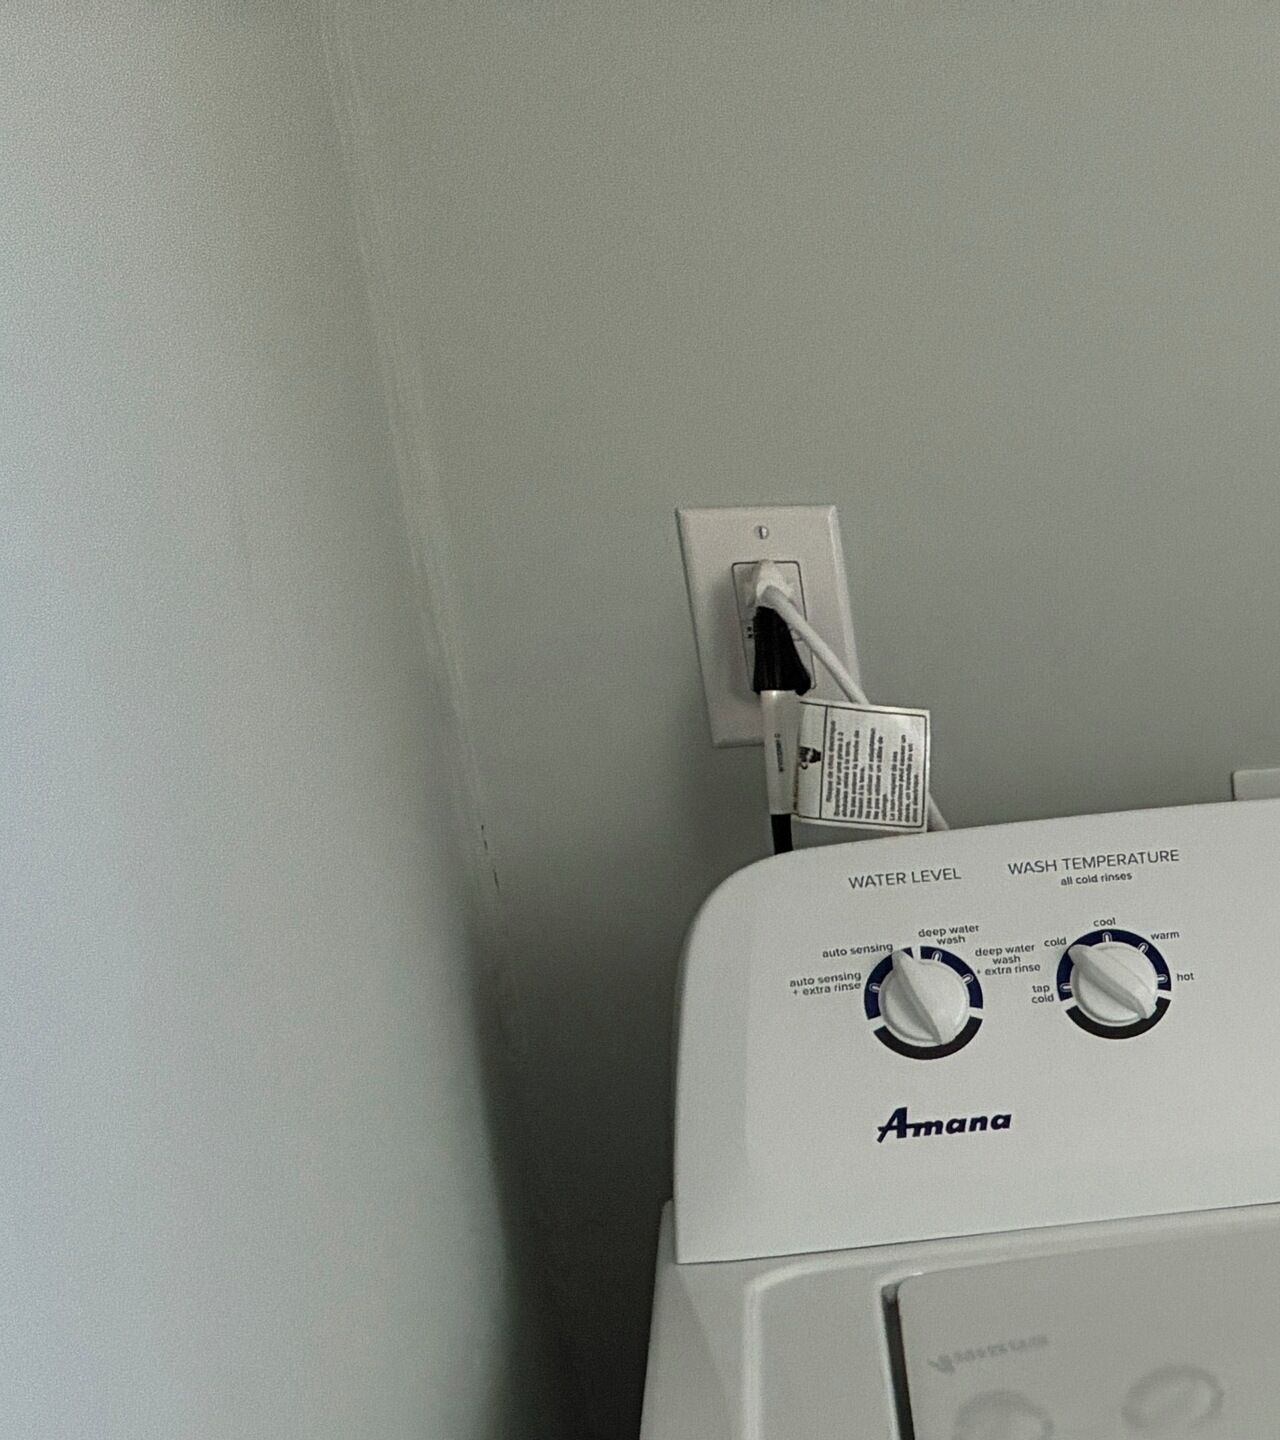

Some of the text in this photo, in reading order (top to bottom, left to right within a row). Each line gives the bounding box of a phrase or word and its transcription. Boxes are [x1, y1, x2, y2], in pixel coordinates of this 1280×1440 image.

[1008, 850, 1180, 875] WASH TEMPERATURE
[849, 868, 962, 889] WATER LEVEL
[1061, 872, 1132, 886] all cold rinses
[1093, 917, 1116, 928] cool
[918, 924, 980, 940] deep water
[1151, 931, 1180, 941] warm
[937, 934, 965, 945] wash
[1044, 937, 1067, 948] cold
[822, 943, 893, 958] auto sensing
[975, 943, 1035, 959] deep water
[992, 954, 1021, 965] wash
[987, 965, 1012, 977] extra
[1015, 963, 1040, 974] rinse
[1176, 971, 1194, 981] hot
[789, 971, 861, 988] auto sensing
[803, 984, 830, 996] extra
[834, 981, 861, 993] rinse
[1032, 983, 1050, 995] tap
[1031, 993, 1054, 1004] cold
[877, 1107, 1012, 1143] Amana
